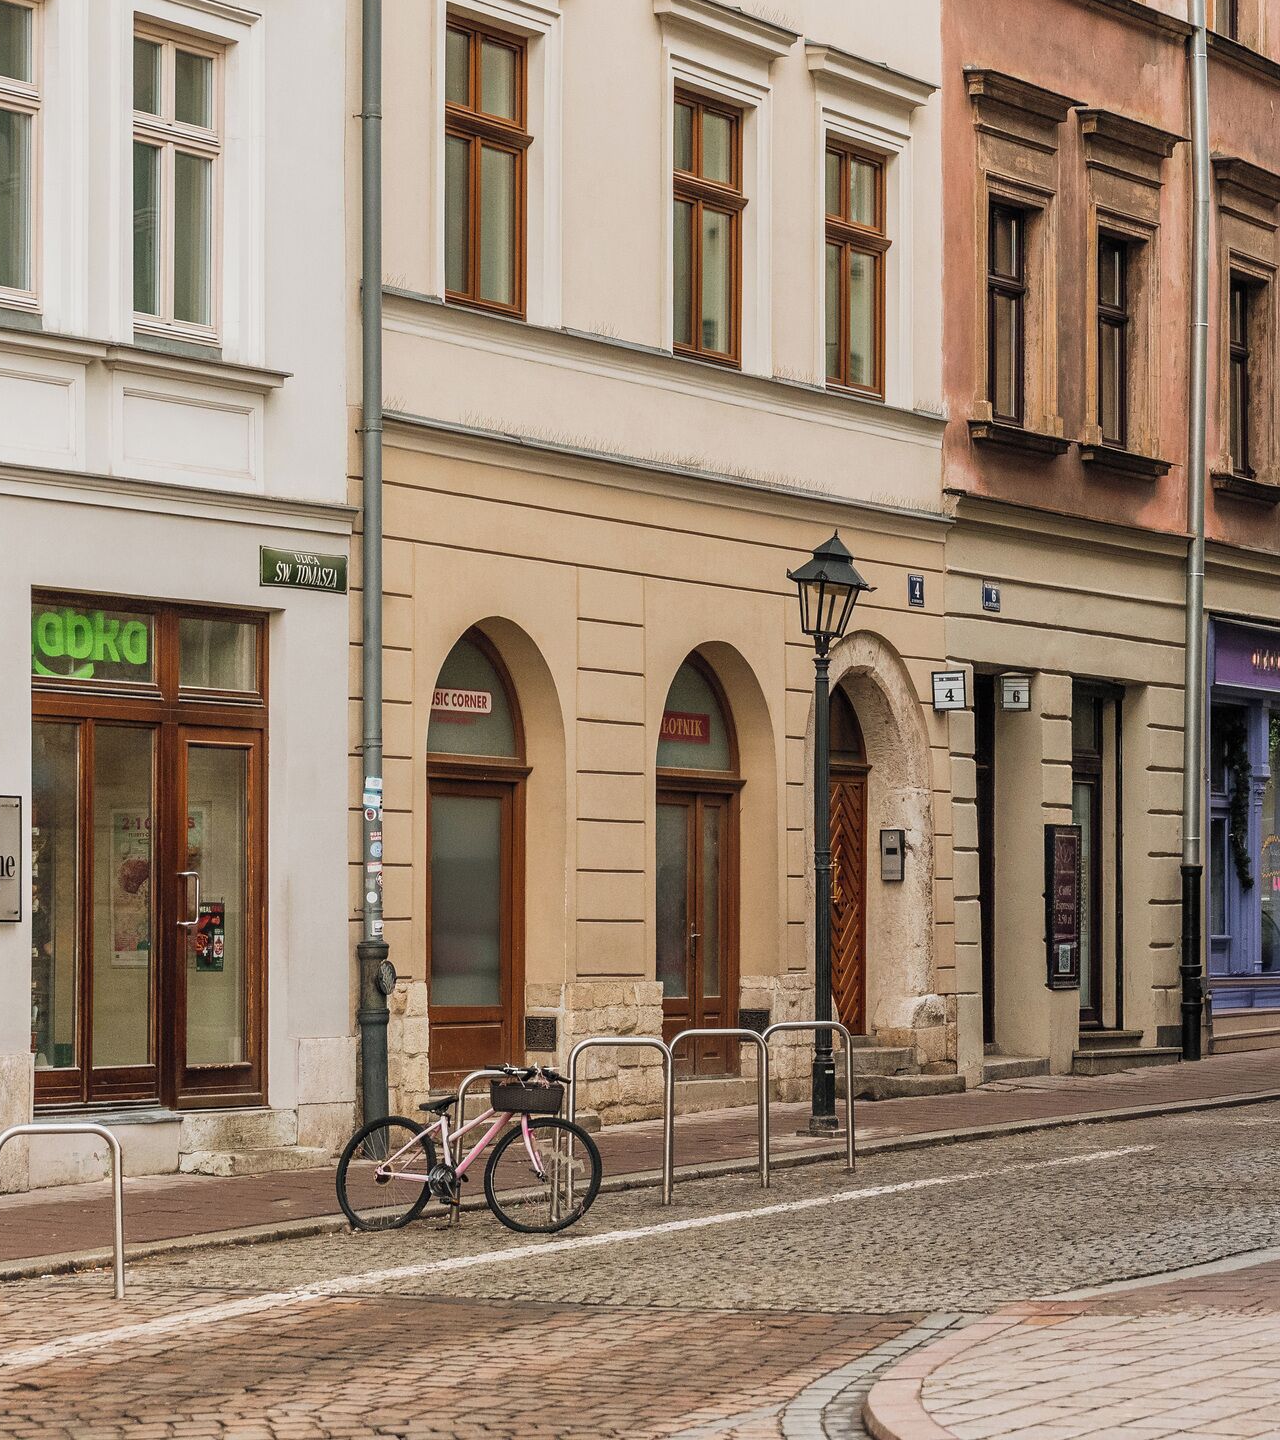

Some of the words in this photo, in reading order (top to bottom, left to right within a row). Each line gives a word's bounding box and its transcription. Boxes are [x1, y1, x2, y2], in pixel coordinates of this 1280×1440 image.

[294, 553, 320, 565] ULICA
[274, 560, 292, 582] ŚW.
[295, 564, 337, 588] TOMASZA
[914, 582, 921, 599] 4
[991, 589, 998, 602] 6
[32, 606, 148, 665] abka
[451, 693, 488, 709] CORNER
[945, 688, 955, 702] 4
[1012, 689, 1021, 703] 6
